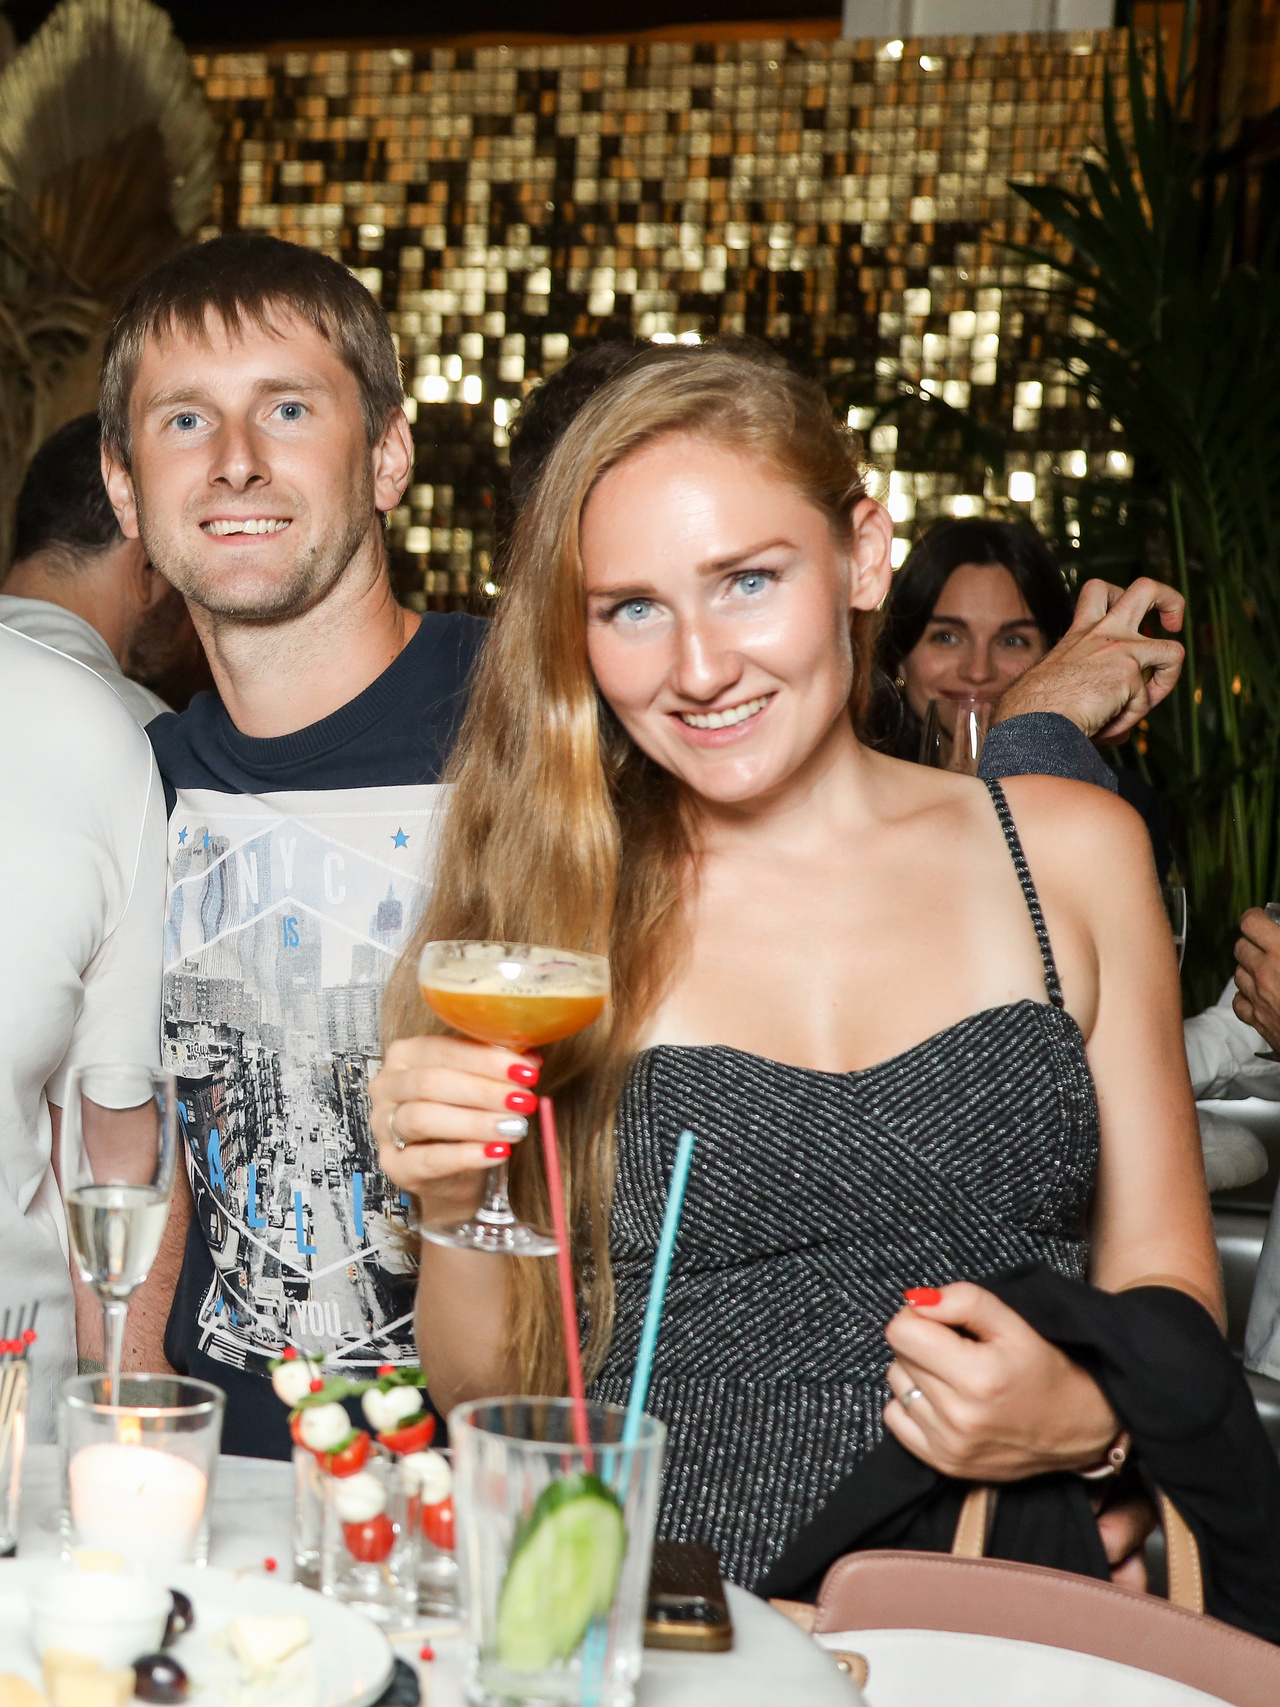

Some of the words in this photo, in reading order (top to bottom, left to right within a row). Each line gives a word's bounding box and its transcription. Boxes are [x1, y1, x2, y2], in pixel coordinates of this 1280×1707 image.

[238, 837, 346, 905] NYC
[282, 917, 299, 947] IS
[294, 1299, 342, 1337] YOU
